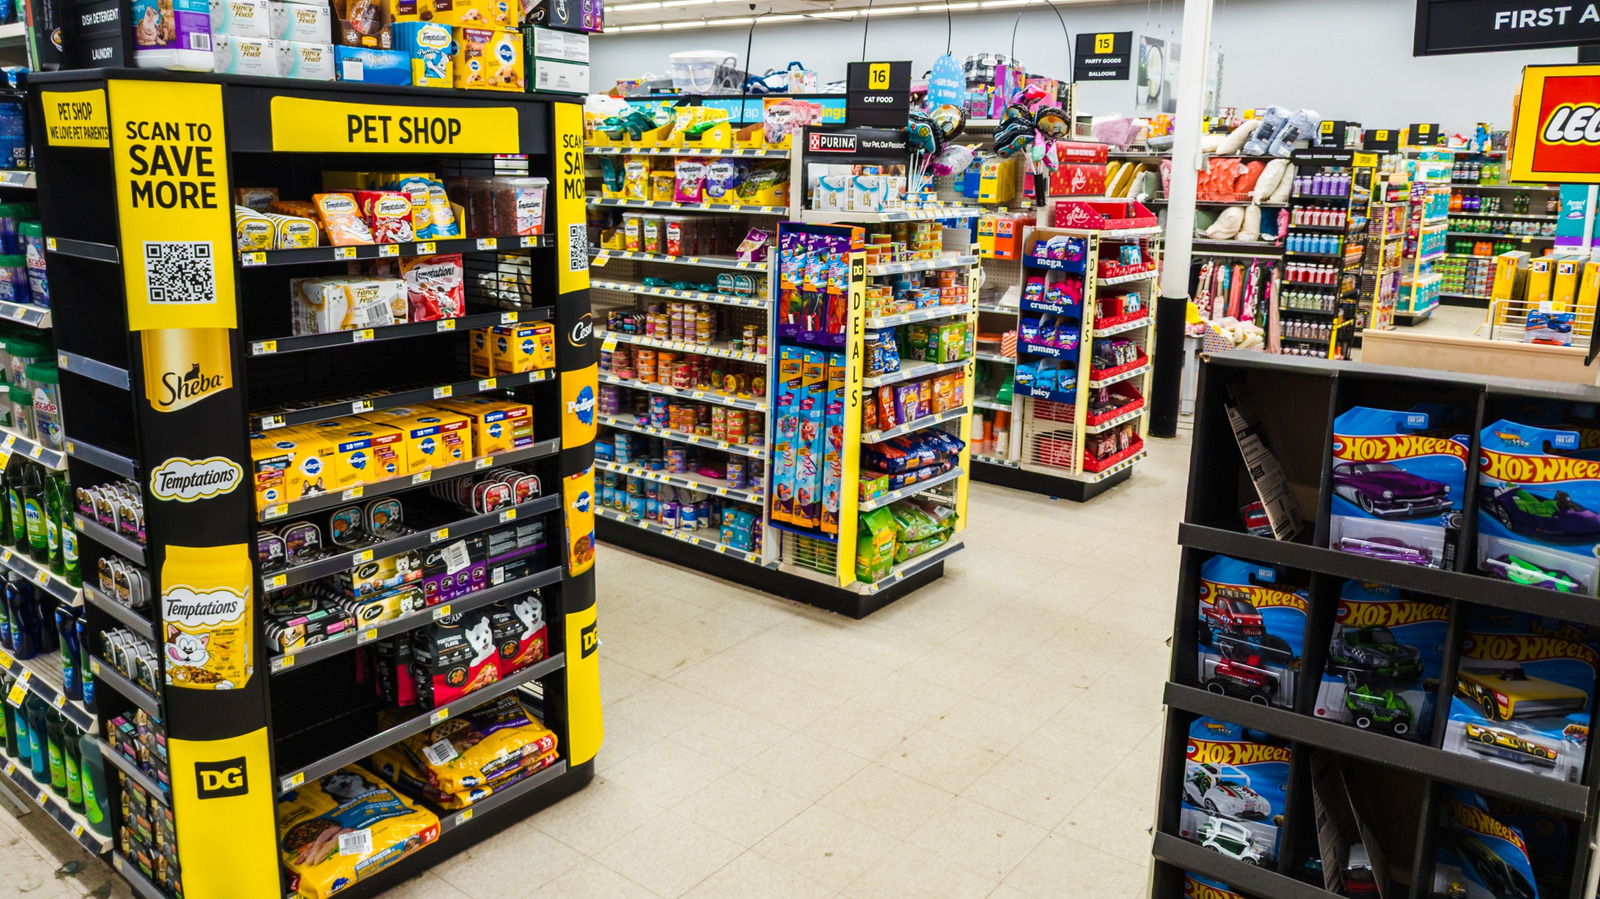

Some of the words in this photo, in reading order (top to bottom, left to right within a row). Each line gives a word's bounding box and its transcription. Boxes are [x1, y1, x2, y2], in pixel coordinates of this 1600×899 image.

[82, 16, 93, 26] DISH
[94, 8, 118, 24] DETERGENT
[1494, 6, 1572, 30] FIRST
[421, 32, 448, 42] Temptations
[1099, 39, 1110, 48] 15
[92, 47, 113, 60] LAUNDRY
[873, 70, 886, 82] 16
[58, 102, 71, 120] PET
[72, 102, 92, 120] SHOP
[731, 105, 759, 120] Wrap
[50, 126, 60, 139] WE
[61, 126, 73, 140] LOVE
[74, 127, 84, 140] PET
[84, 127, 108, 140] PARENTS
[126, 121, 180, 141] SCAN
[186, 124, 212, 142] TO
[347, 114, 392, 143] PET
[398, 116, 462, 144] SHOP
[821, 136, 855, 148] PURINA
[862, 140, 870, 148] Your
[130, 144, 214, 176] SAVE
[131, 181, 217, 208] MORE
[324, 198, 354, 210] Temptations
[380, 202, 408, 213] Temptations
[518, 201, 540, 210] Temptations
[1066, 208, 1090, 226] glade
[1037, 258, 1064, 268] mega.
[414, 266, 454, 283] Temptations
[853, 264, 863, 276] DG
[352, 288, 380, 298] Fancy
[1030, 302, 1064, 314] crunchy.
[852, 292, 860, 407] DEALS
[1027, 344, 1060, 356] gummy.
[158, 372, 221, 406] Sheba
[1030, 387, 1050, 398] juicy
[1532, 456, 1600, 482] WHEE
[160, 468, 234, 493] Temptations
[361, 566, 378, 577] Cesar
[167, 600, 238, 620] Temptations
[365, 608, 382, 618] Cesar
[438, 634, 462, 645] PORTERHOUSE
[200, 768, 244, 791] DG
[425, 828, 437, 841] 14
